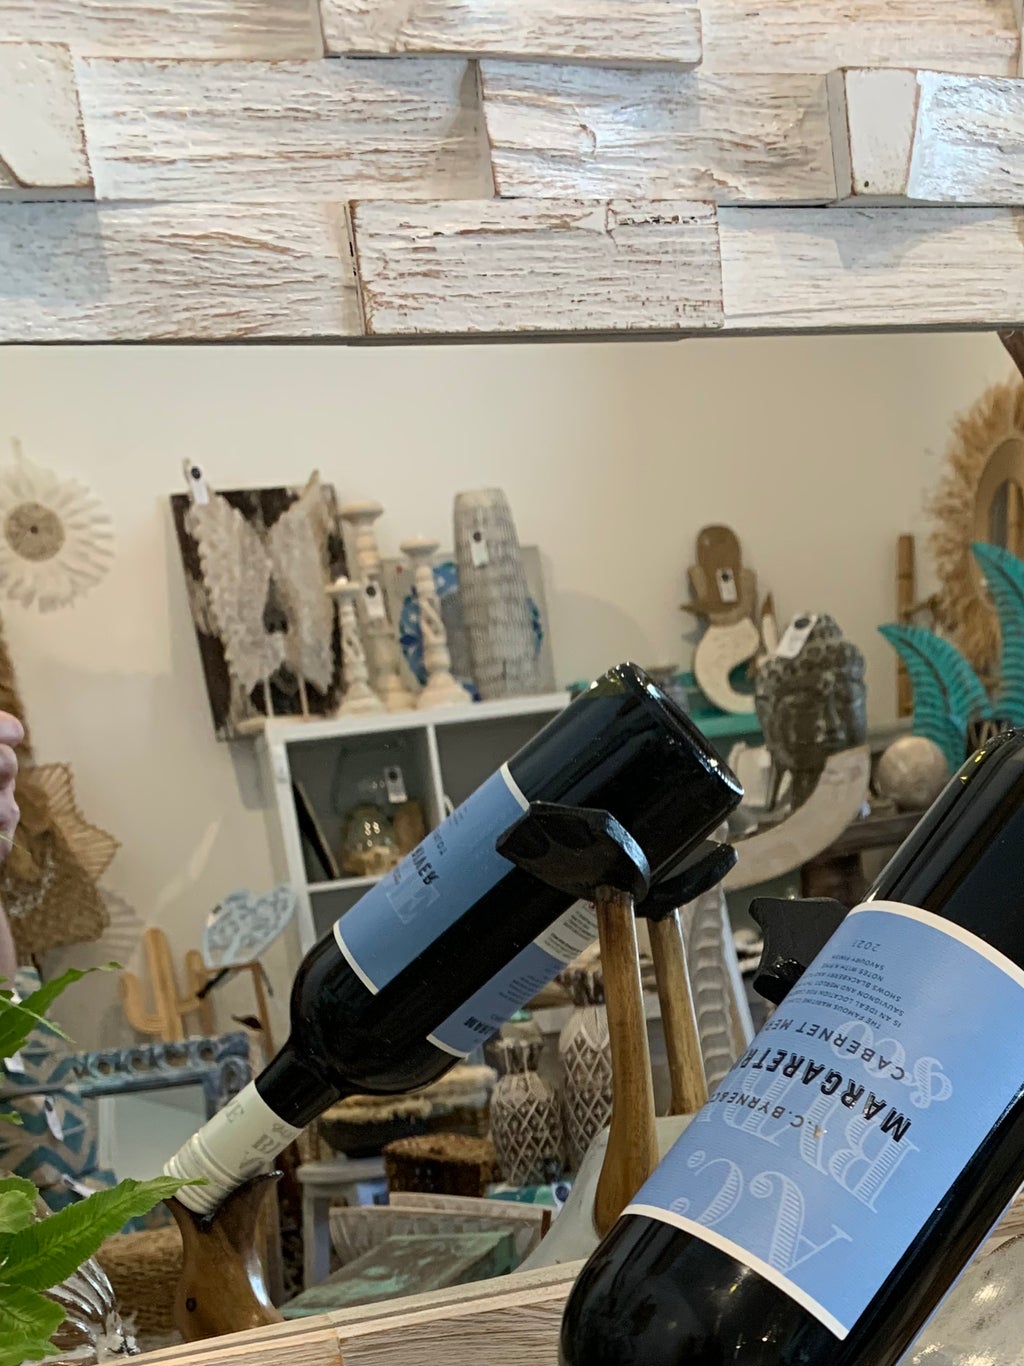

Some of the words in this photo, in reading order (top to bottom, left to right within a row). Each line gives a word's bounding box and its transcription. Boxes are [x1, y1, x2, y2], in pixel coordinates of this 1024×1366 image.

[857, 968, 884, 982] NOTES
[839, 983, 856, 993] AND
[871, 984, 902, 1002] SHOWS
[817, 989, 853, 1003] LOCATION
[856, 989, 905, 1017] SAUVIGNON
[832, 1003, 865, 1020] FAMOUS
[854, 1000, 878, 1015] IDEAL
[864, 1016, 881, 1029] THE
[878, 1011, 892, 1022] AN
[891, 1019, 901, 1028] IS
[794, 1021, 904, 1080] CABERNET
[751, 1046, 912, 1142] MARGARET
